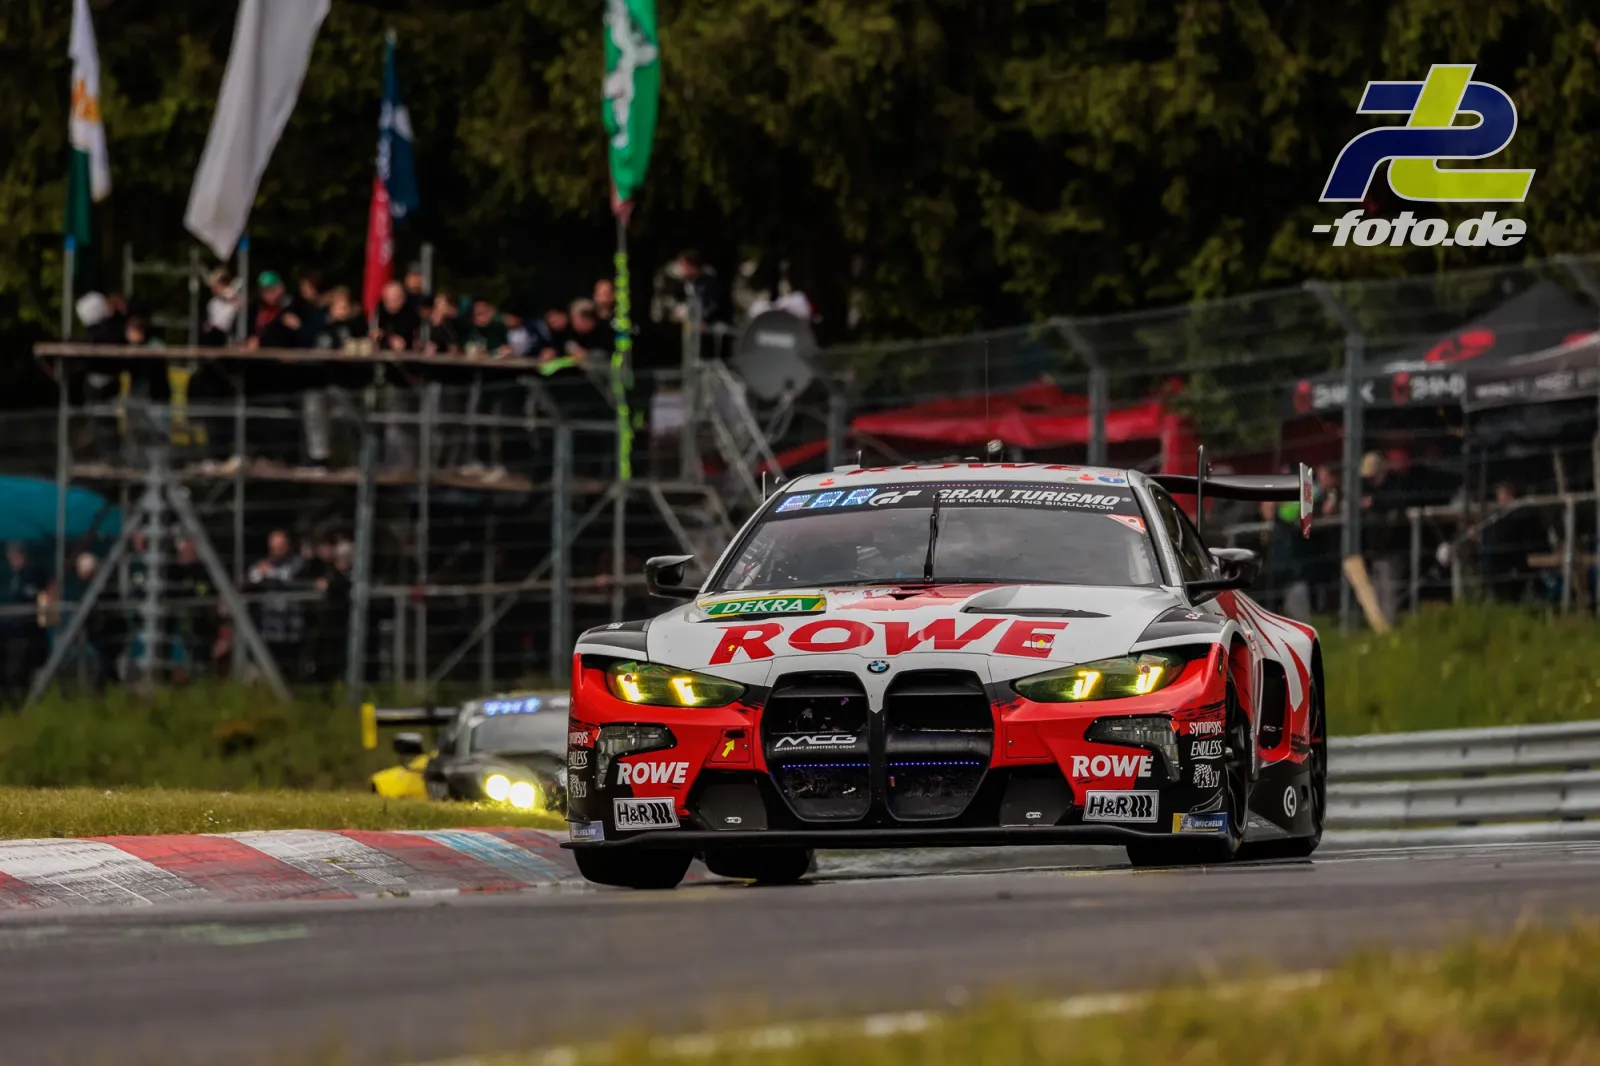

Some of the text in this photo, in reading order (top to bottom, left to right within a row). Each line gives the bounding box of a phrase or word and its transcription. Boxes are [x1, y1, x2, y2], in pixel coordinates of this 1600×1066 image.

[933, 488, 1005, 500] GRAN
[1045, 501, 1114, 511] SIMULATOR
[721, 599, 803, 614] DEKRA
[708, 618, 1069, 665] ROWE
[1189, 721, 1222, 738] SYNOPSYS
[775, 734, 857, 748] MCG
[1190, 740, 1222, 756] ENDLESS
[616, 762, 690, 785] ROWE
[1070, 755, 1154, 778] ROWE
[617, 803, 652, 824] H&R
[1088, 796, 1128, 816] H&R
